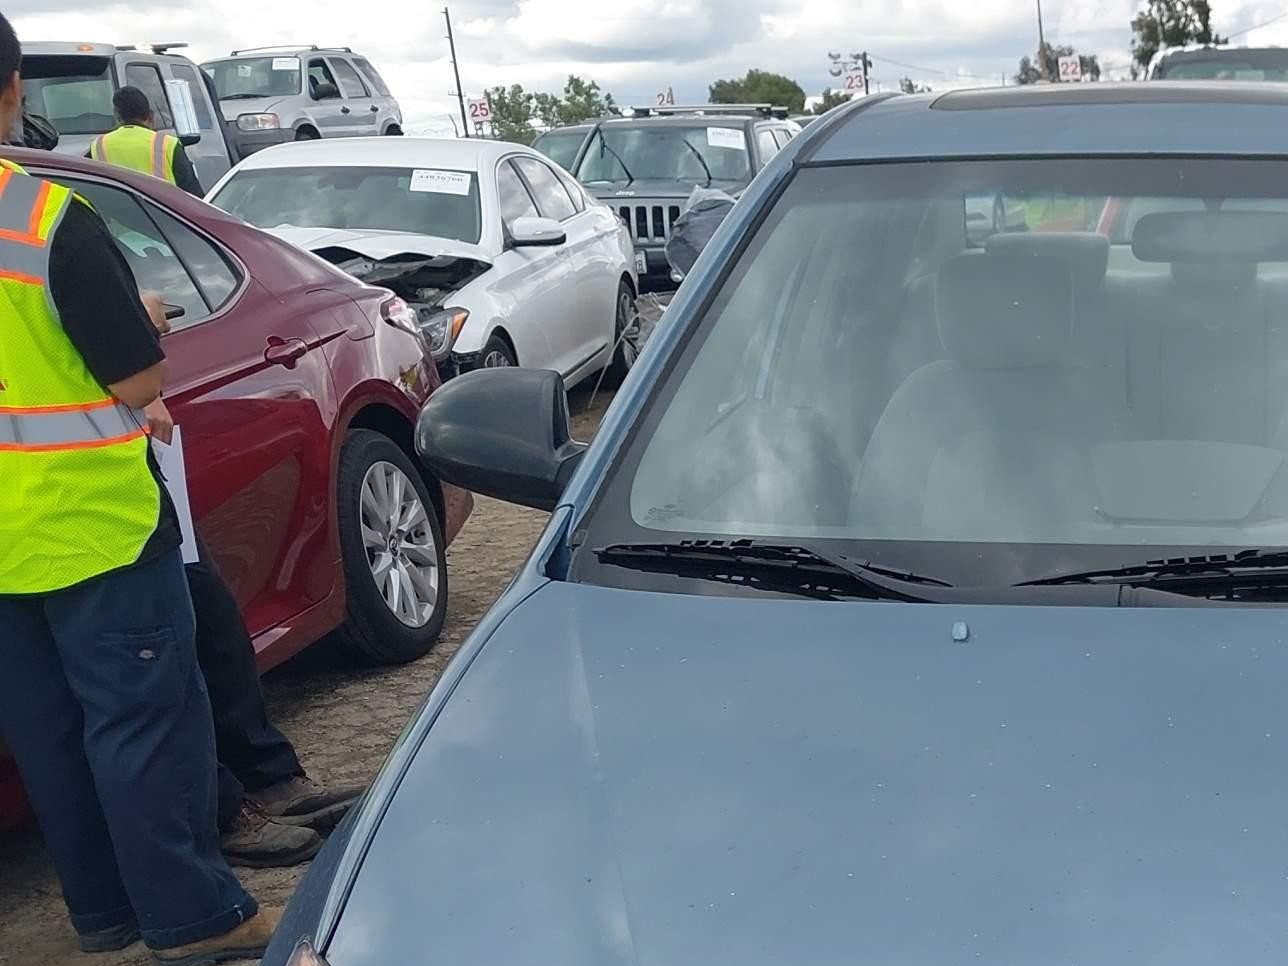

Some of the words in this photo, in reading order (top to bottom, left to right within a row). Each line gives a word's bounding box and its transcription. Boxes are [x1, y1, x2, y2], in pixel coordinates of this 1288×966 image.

[1060, 61, 1079, 76] 22
[846, 74, 864, 90] 23
[656, 86, 674, 106] 24
[468, 102, 489, 118] 25
